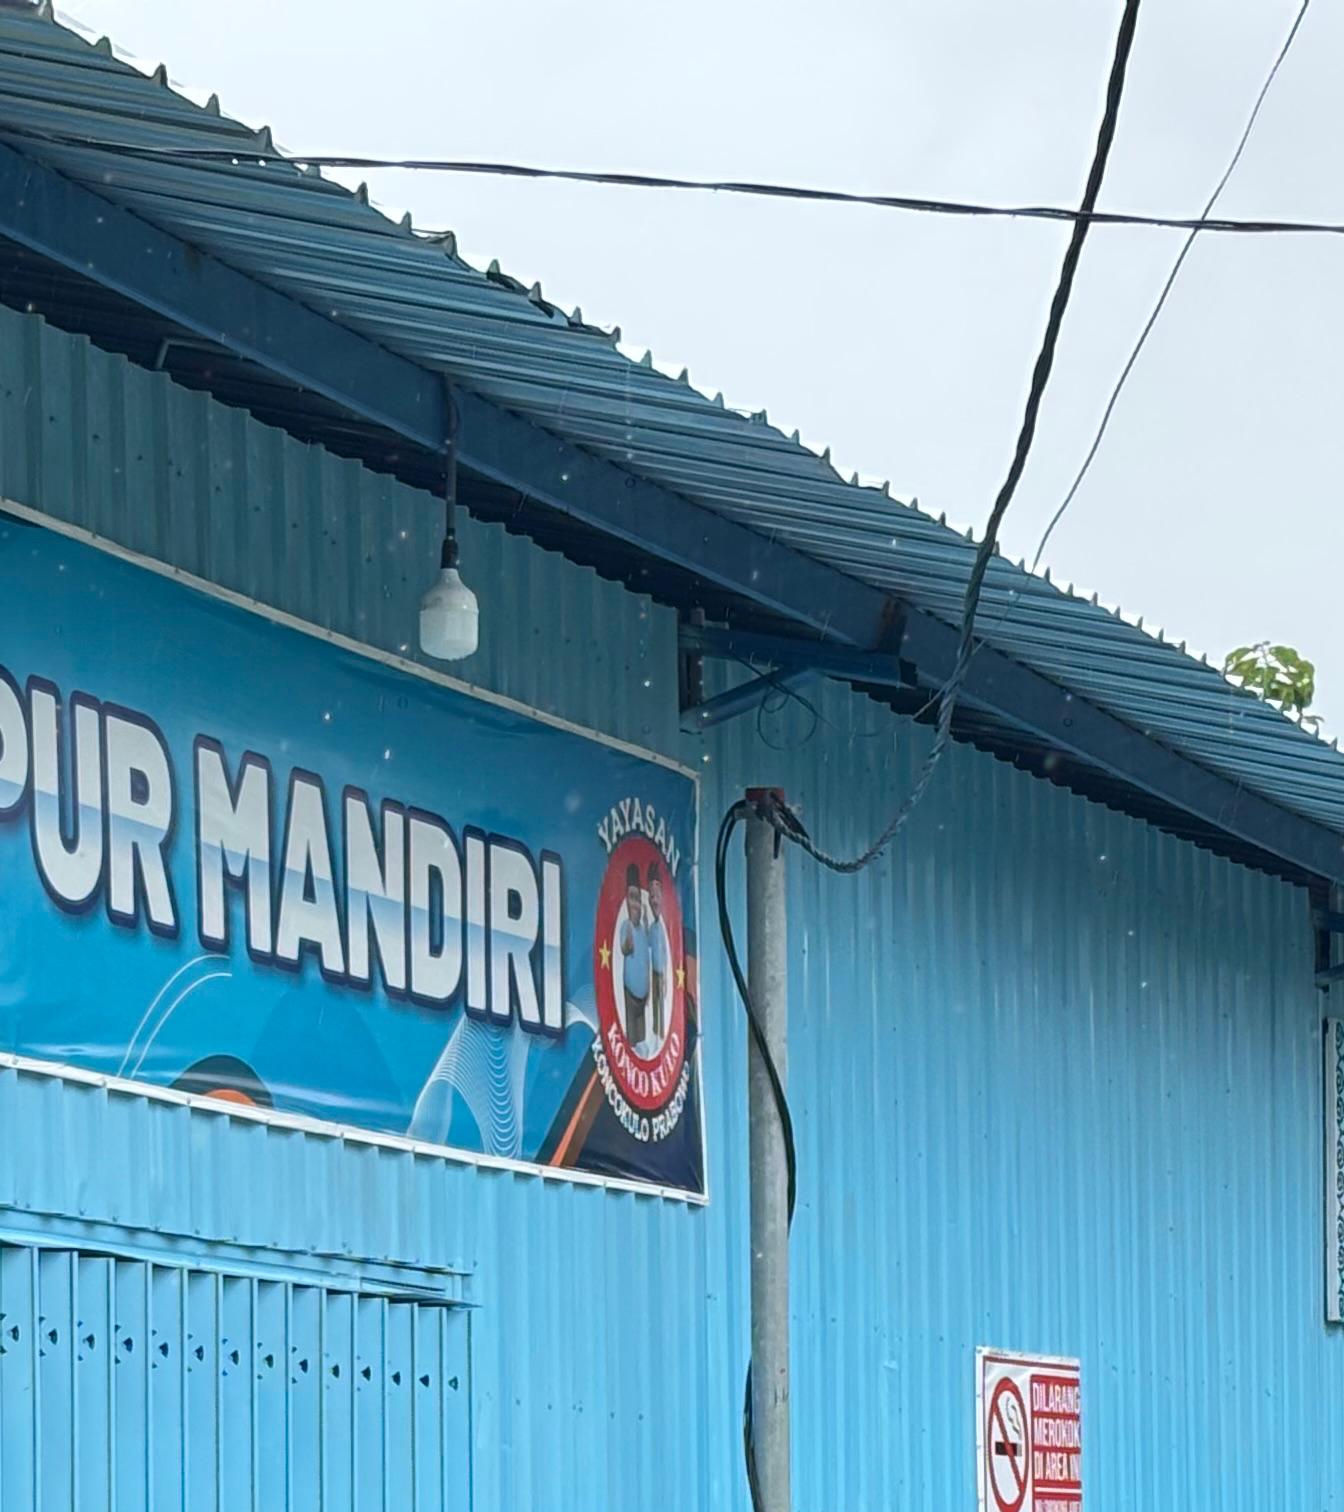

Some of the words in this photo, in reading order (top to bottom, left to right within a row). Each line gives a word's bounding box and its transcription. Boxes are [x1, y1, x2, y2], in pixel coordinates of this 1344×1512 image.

[597, 797, 681, 877] YAYASAN
[193, 732, 566, 1038] MANDIRI
[1033, 1383, 1080, 1413] DILARANG
